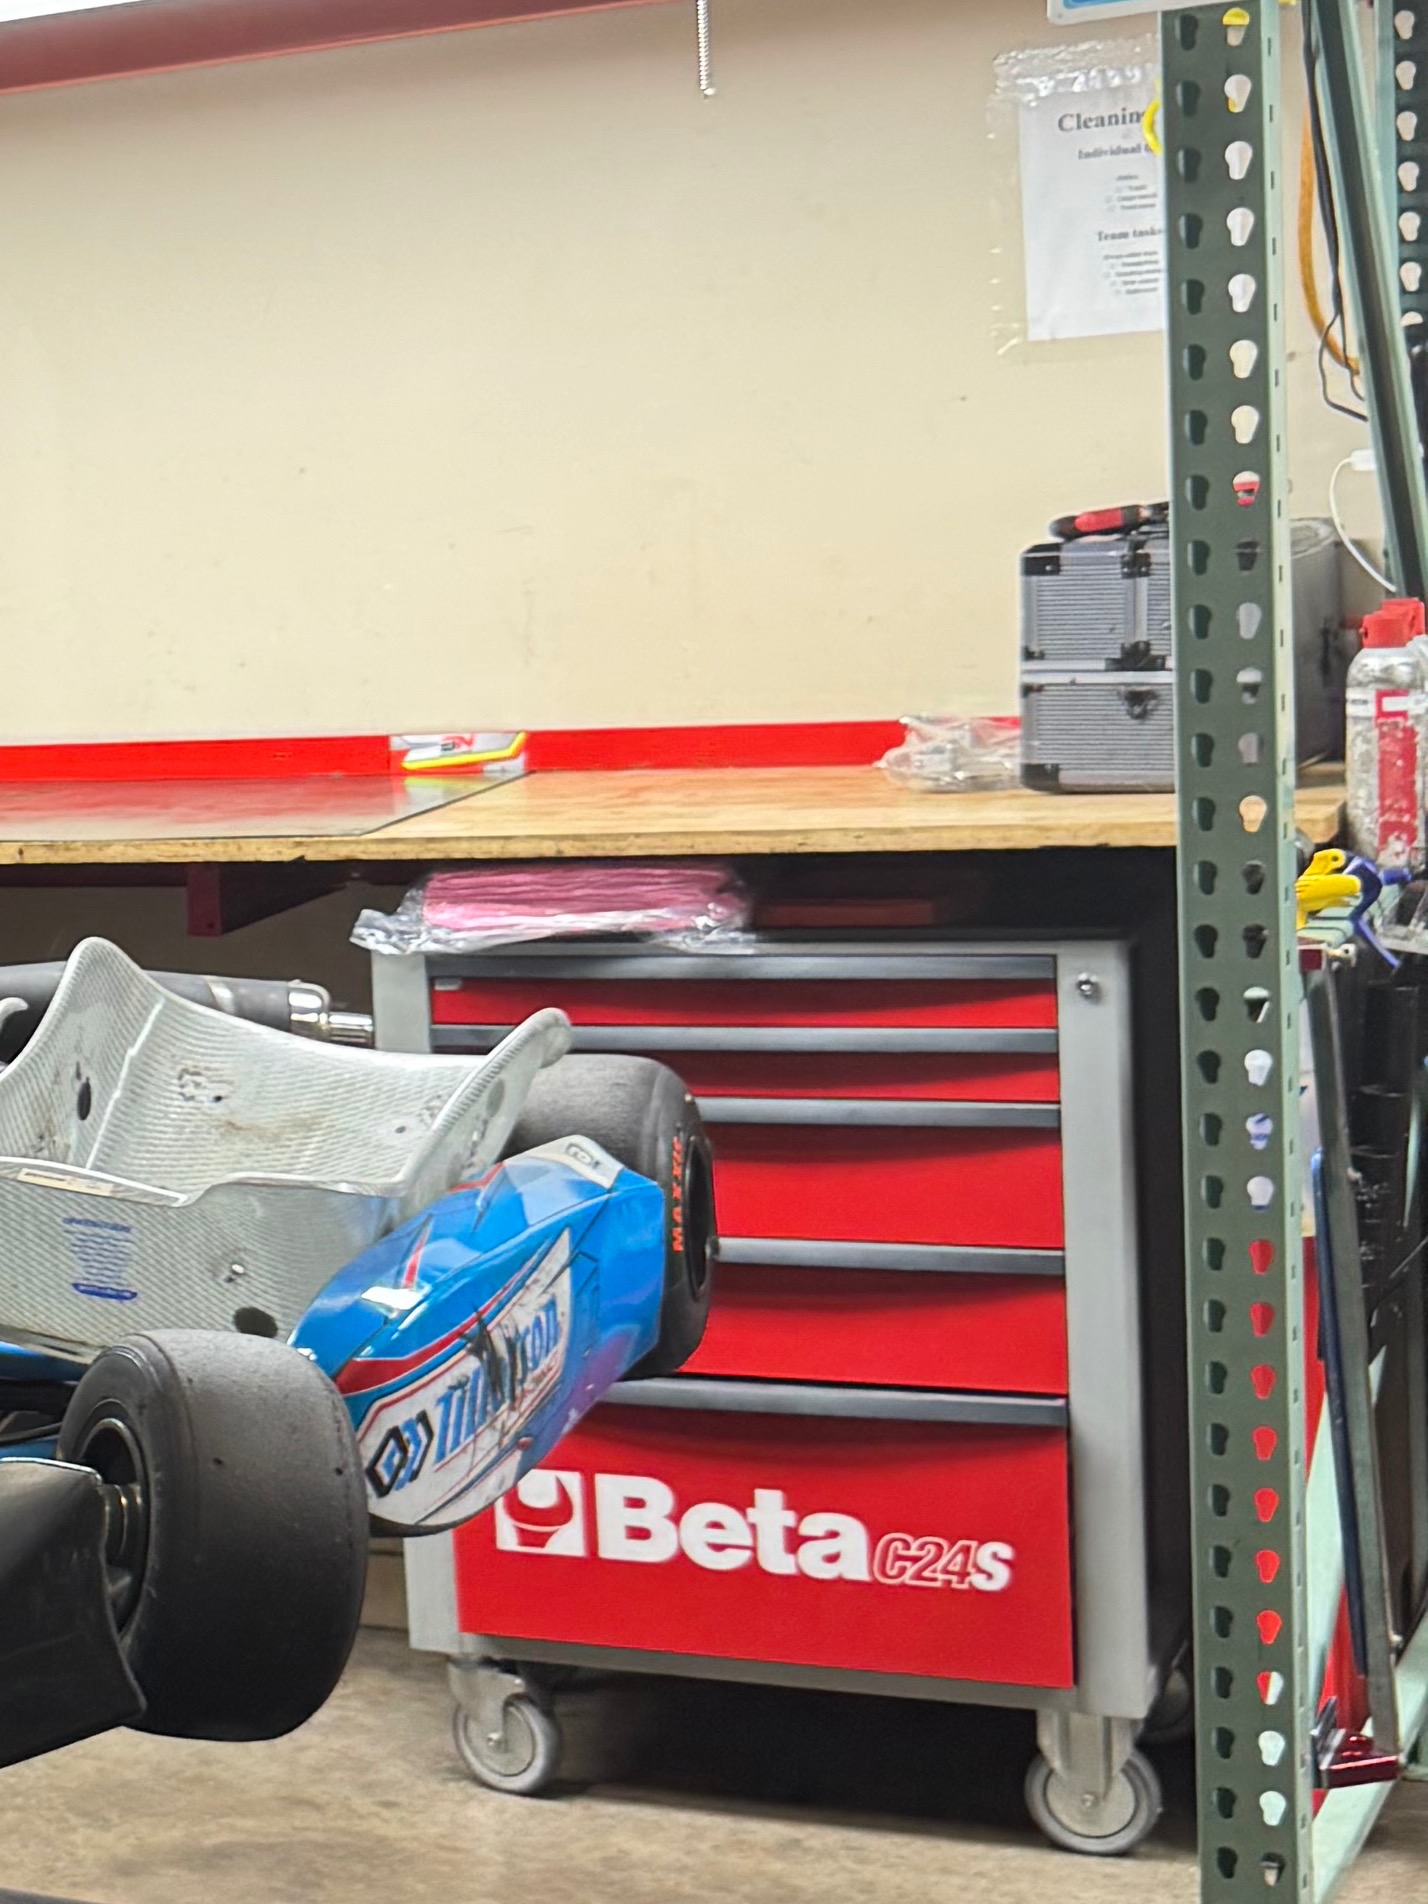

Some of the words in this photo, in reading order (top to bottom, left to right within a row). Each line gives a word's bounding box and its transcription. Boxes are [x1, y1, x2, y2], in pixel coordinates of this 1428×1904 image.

[1097, 230, 1129, 242] Team
[594, 1473, 872, 1583] Beta
[873, 1533, 1015, 1592] C24S
